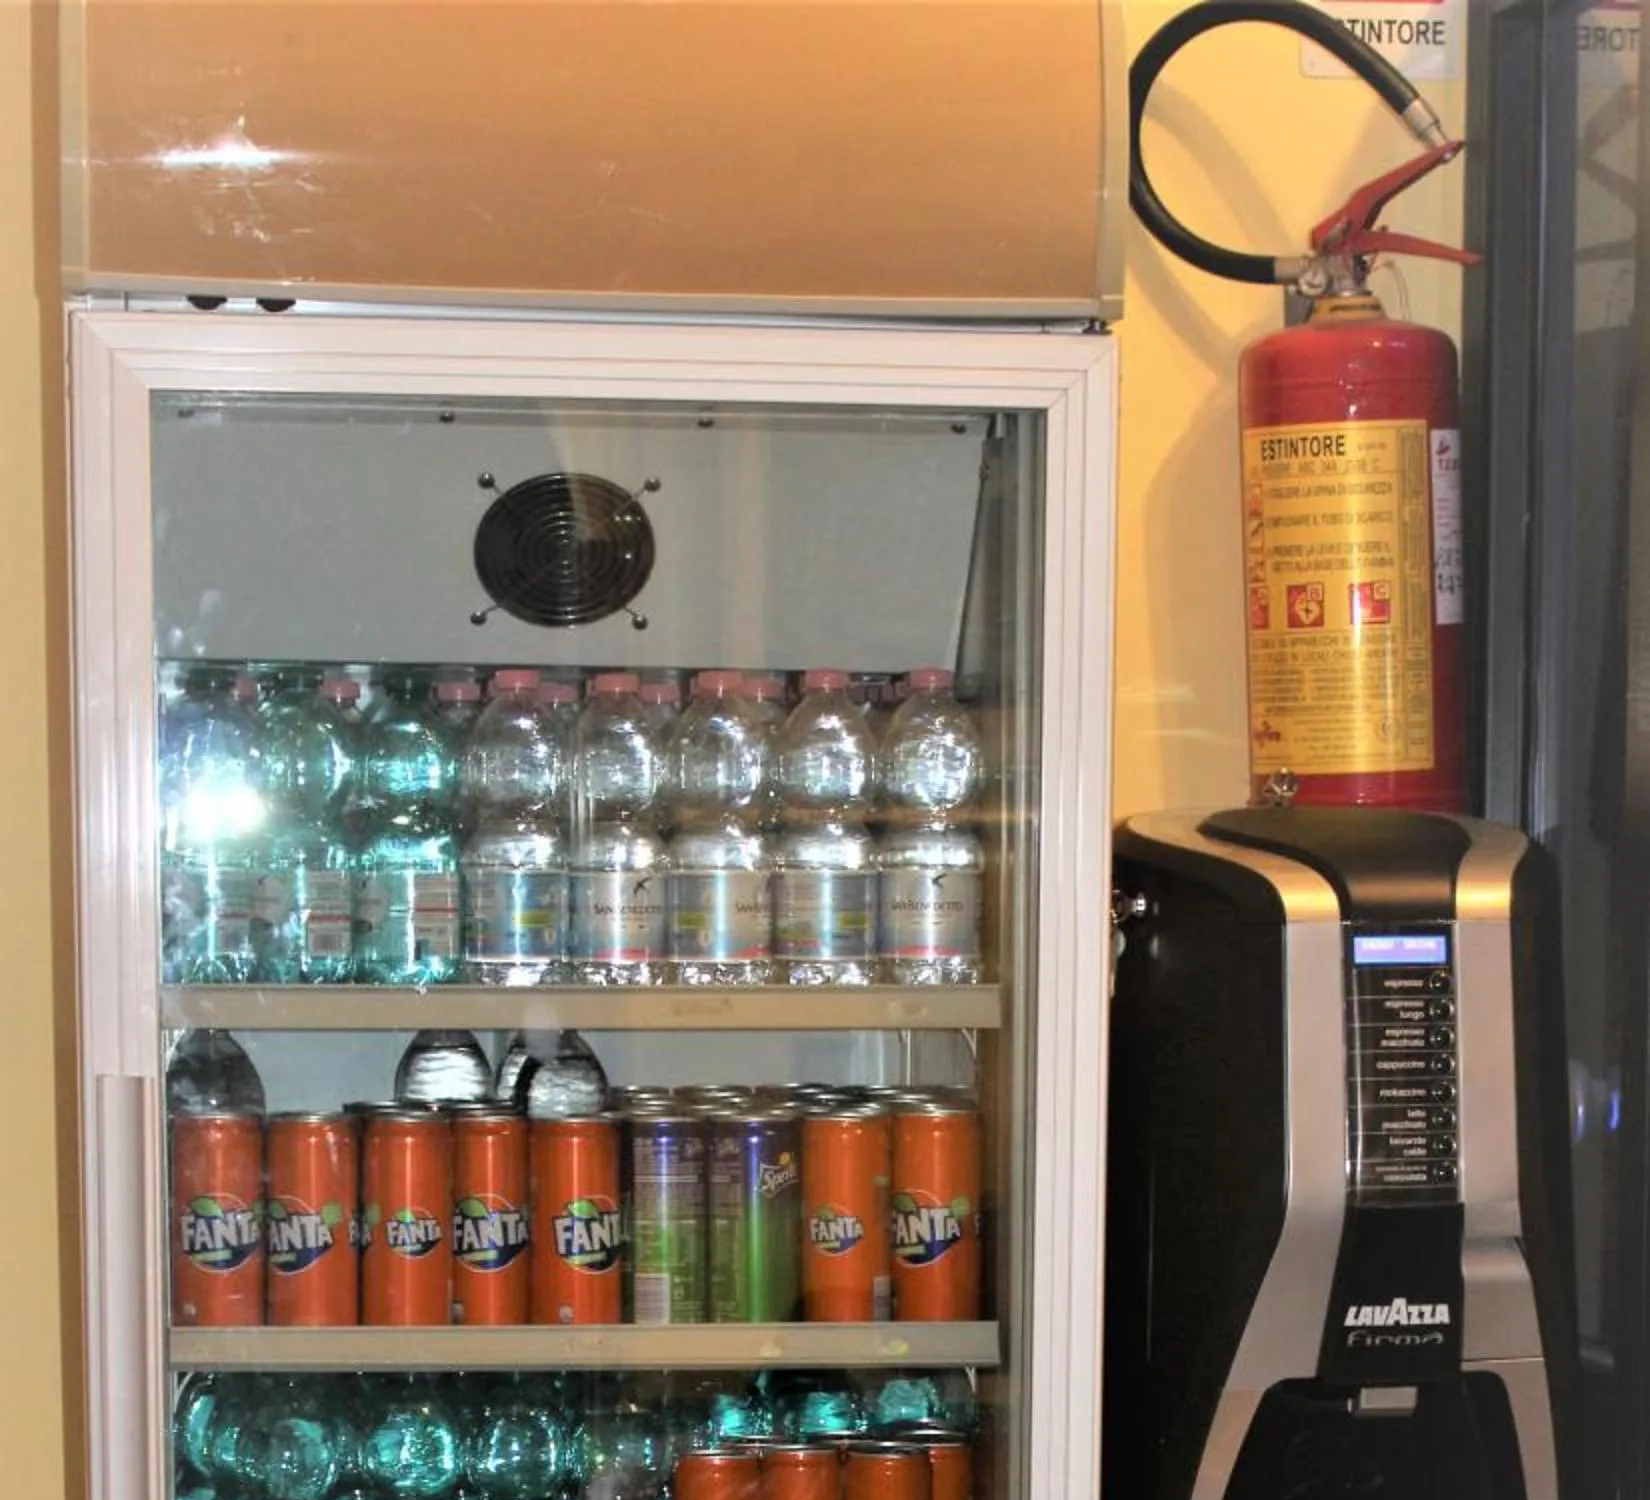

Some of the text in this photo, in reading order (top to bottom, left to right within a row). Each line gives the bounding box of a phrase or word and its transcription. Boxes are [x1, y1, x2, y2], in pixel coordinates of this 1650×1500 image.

[1344, 19, 1447, 46] TINTORE
[1260, 434, 1346, 461] ESTINTORE
[181, 1211, 261, 1252] FANTA
[269, 1213, 334, 1254] ANTA
[386, 1217, 442, 1246] FANTA
[453, 1211, 529, 1252] FANTA
[554, 1212, 623, 1256] FANT
[808, 1215, 865, 1242] FANTA
[1344, 1297, 1450, 1327] LAVAZZA
